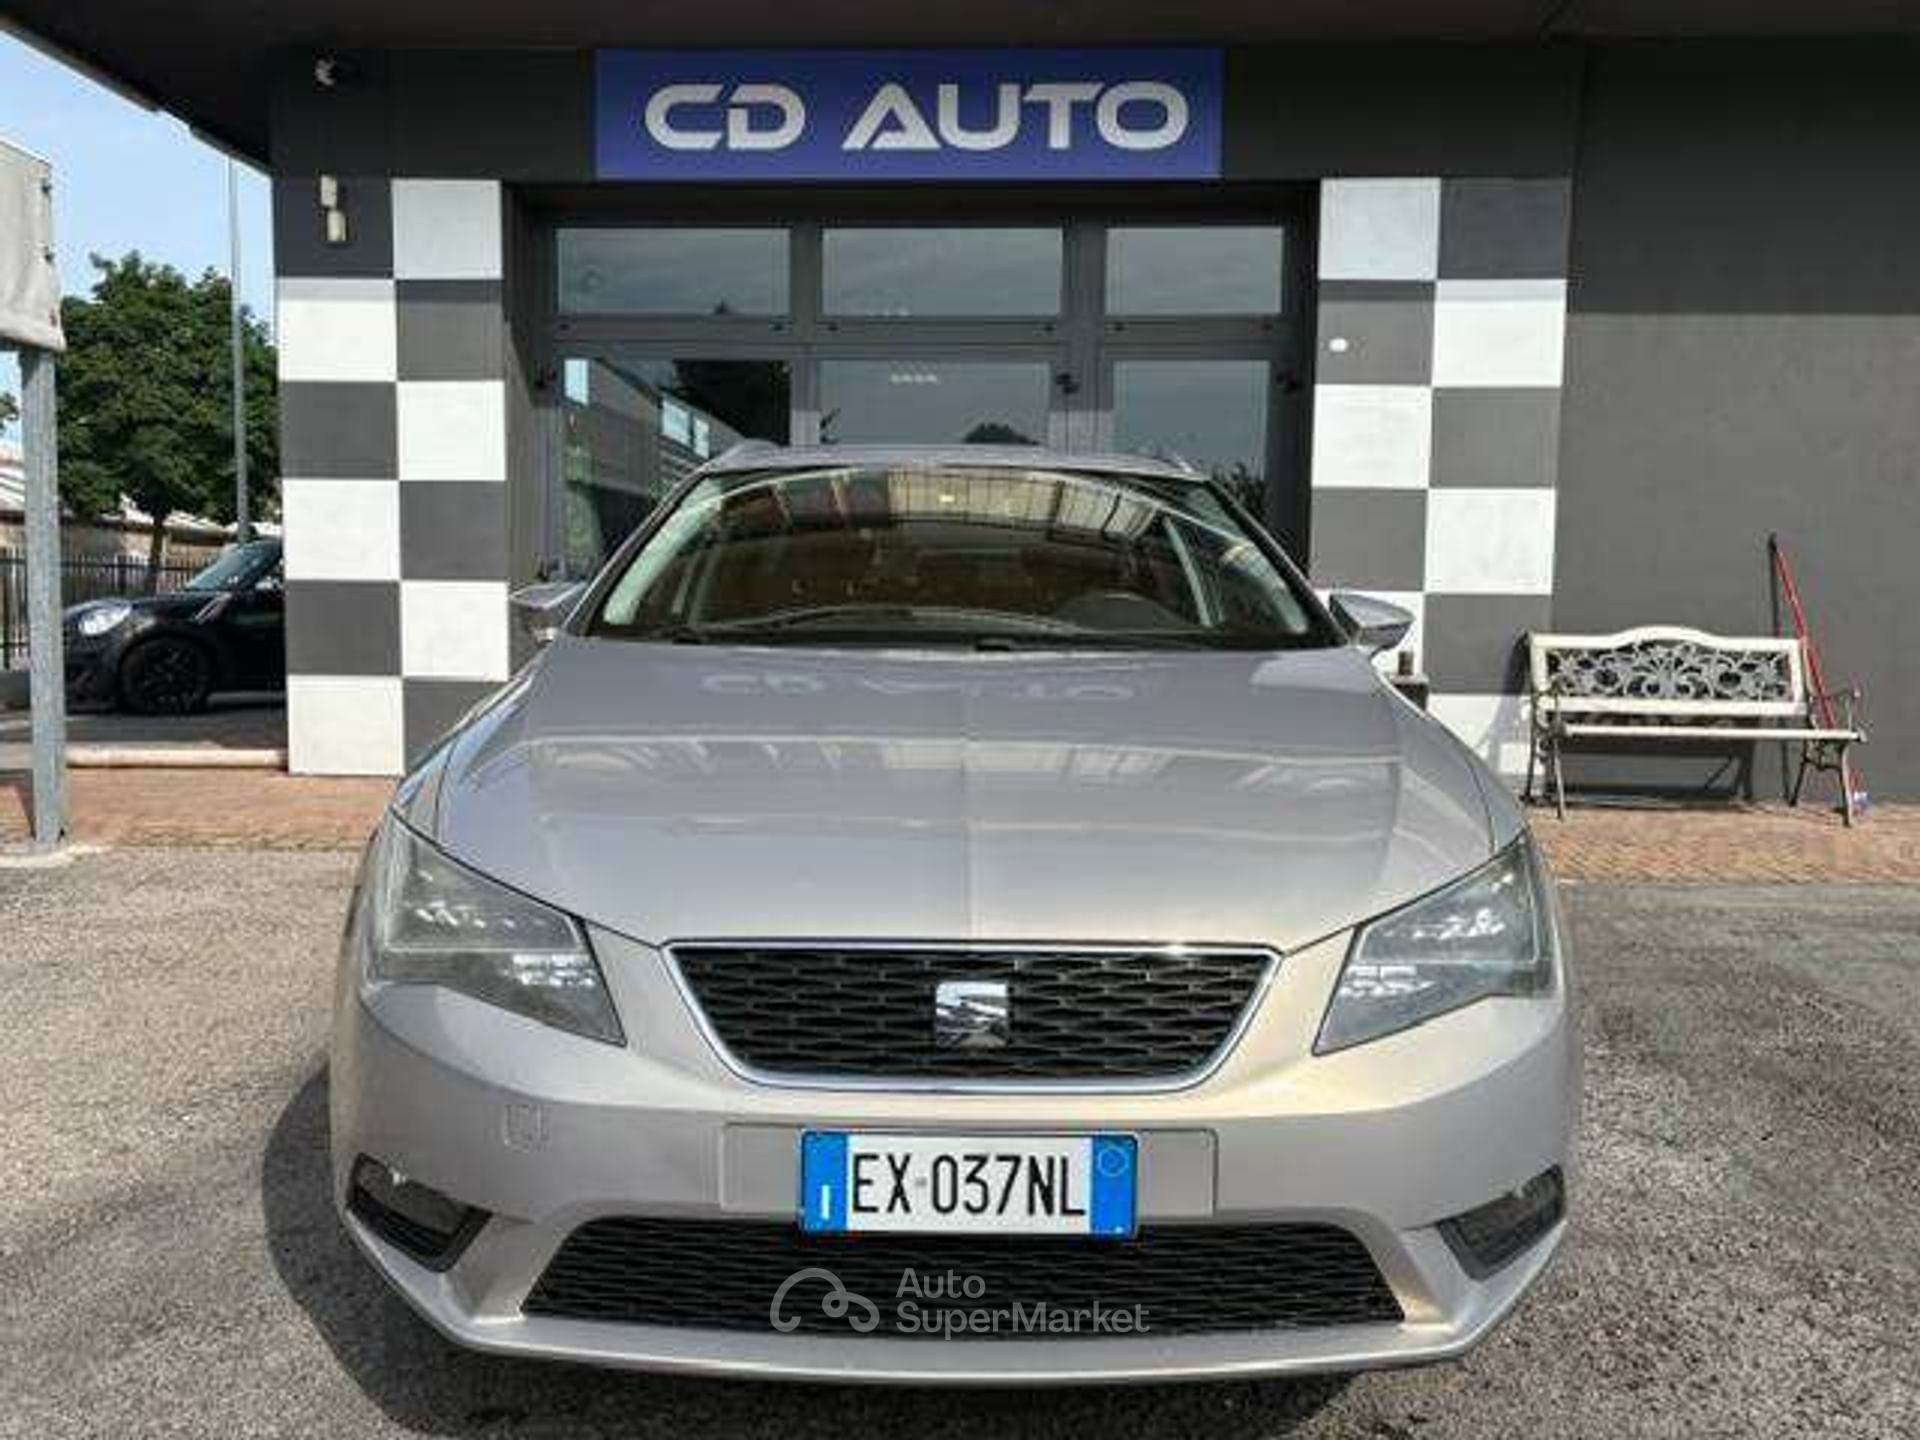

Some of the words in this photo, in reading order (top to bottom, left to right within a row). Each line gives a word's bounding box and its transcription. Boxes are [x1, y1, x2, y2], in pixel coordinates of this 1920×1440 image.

[644, 83, 805, 150] CD
[841, 81, 1190, 150] AUTO
[853, 1153, 912, 1215] EX
[931, 1154, 1087, 1217] 037NL
